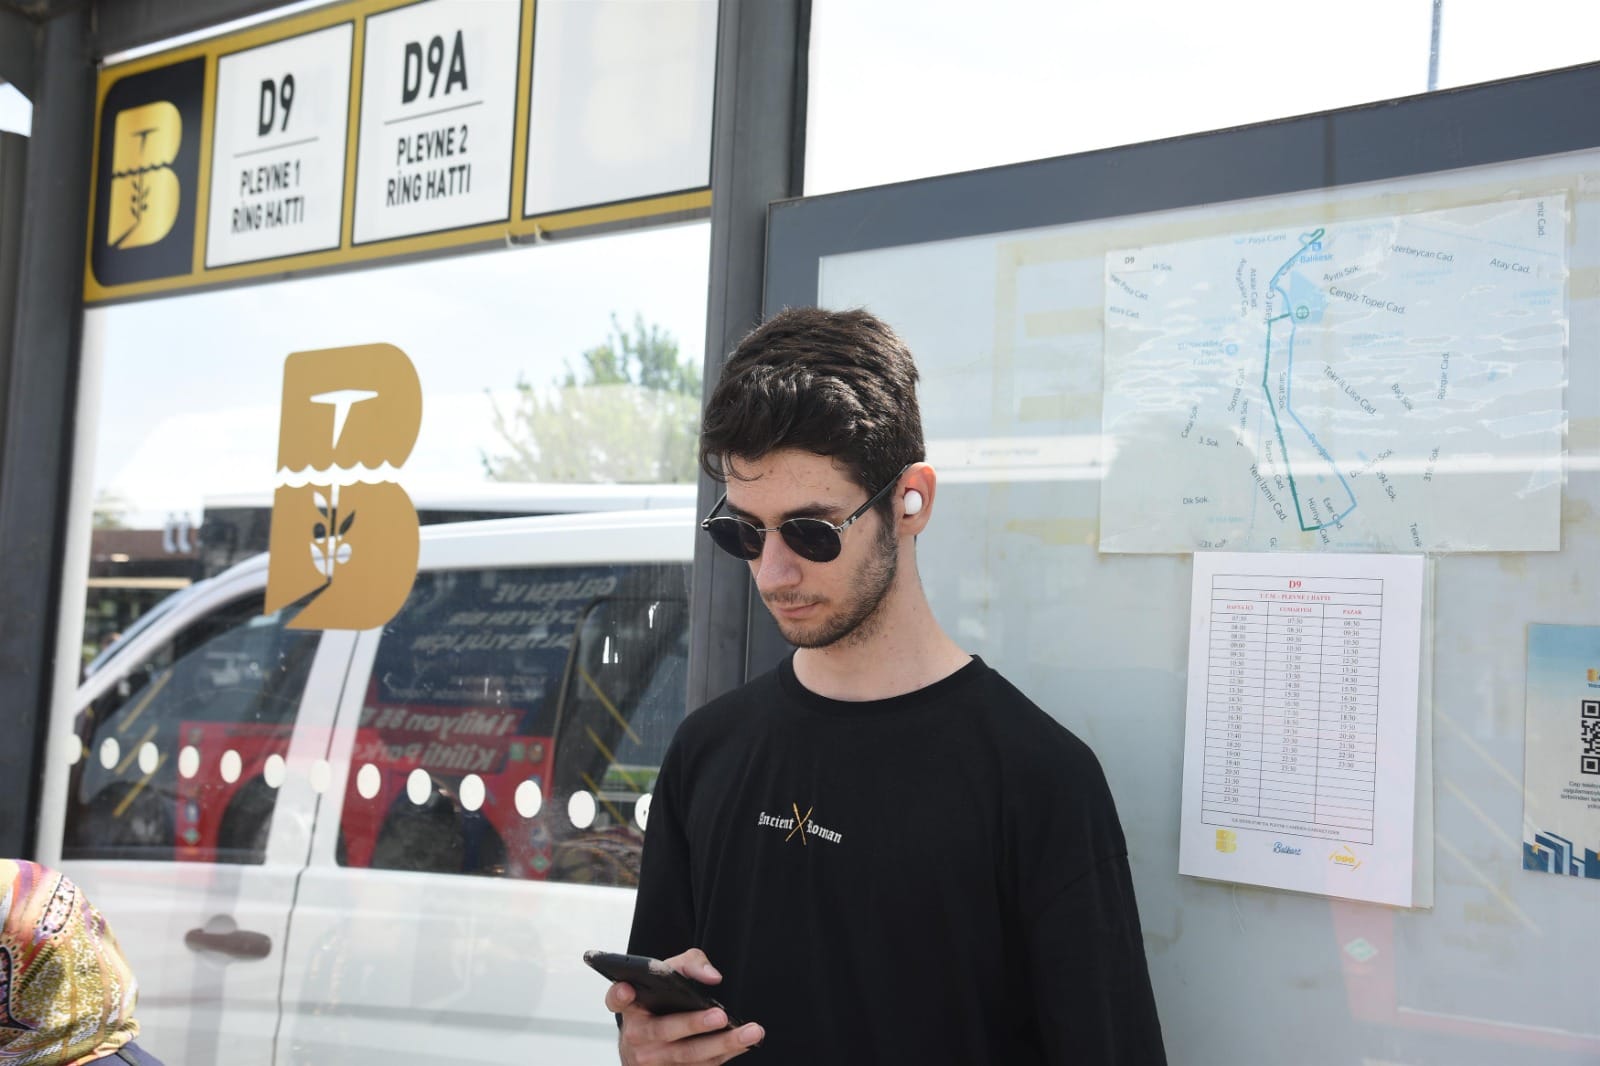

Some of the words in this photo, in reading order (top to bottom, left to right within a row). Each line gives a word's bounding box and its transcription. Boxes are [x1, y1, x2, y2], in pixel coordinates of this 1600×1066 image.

[403, 30, 468, 105] D9A
[258, 74, 295, 137] D9
[398, 131, 455, 167] PLEVNE
[458, 125, 469, 154] 2
[240, 165, 293, 196] PLEVNE
[294, 161, 302, 187] 1
[386, 171, 423, 208] RİNG
[426, 163, 472, 202] HATTI
[264, 196, 305, 229] HATTI
[1124, 256, 1135, 264] D9
[1489, 257, 1509, 271] Atay
[1328, 286, 1359, 302] Cengiz
[1361, 294, 1385, 310] Topel
[1288, 580, 1302, 589] D9
[757, 811, 795, 830] Ancient
[806, 819, 843, 844] Roman
